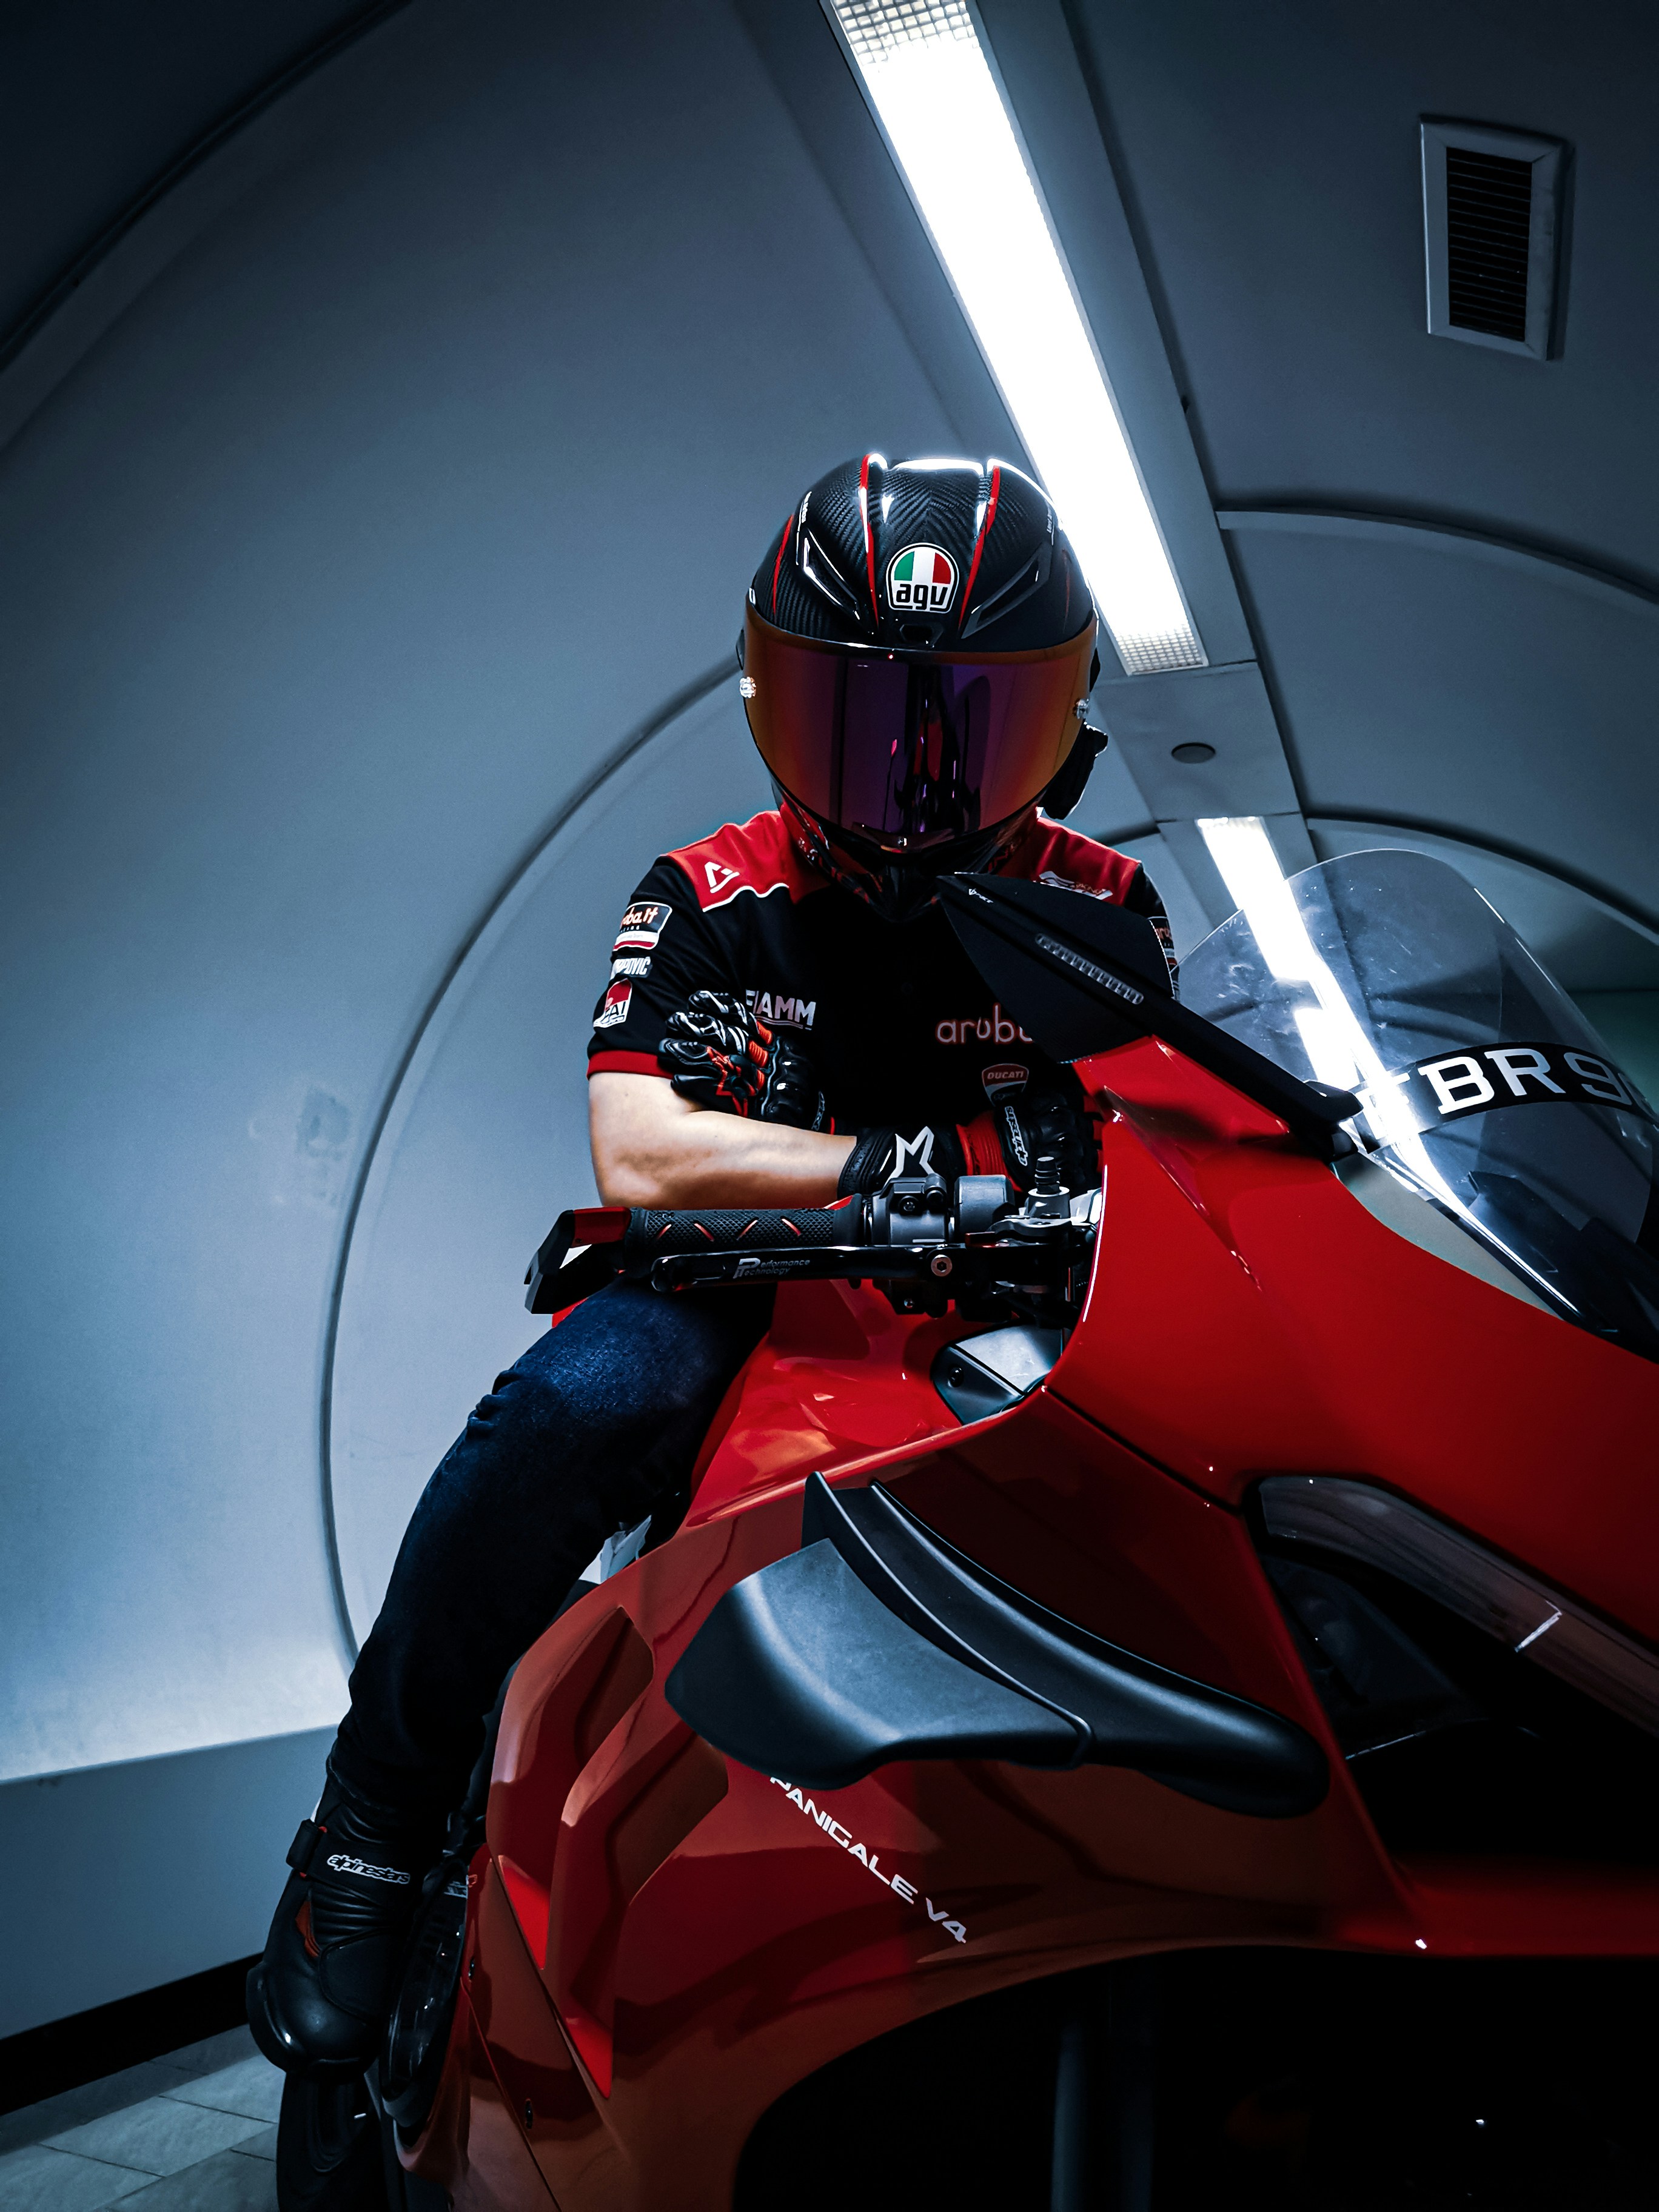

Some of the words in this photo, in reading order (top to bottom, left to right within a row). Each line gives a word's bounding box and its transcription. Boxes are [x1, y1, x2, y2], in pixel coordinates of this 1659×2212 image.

[896, 583, 948, 611] agv
[745, 989, 817, 1026] FIAMM
[987, 1071, 1024, 1080] DUCATI
[327, 1854, 411, 1885] alpinestars
[925, 1897, 967, 1944] V4
